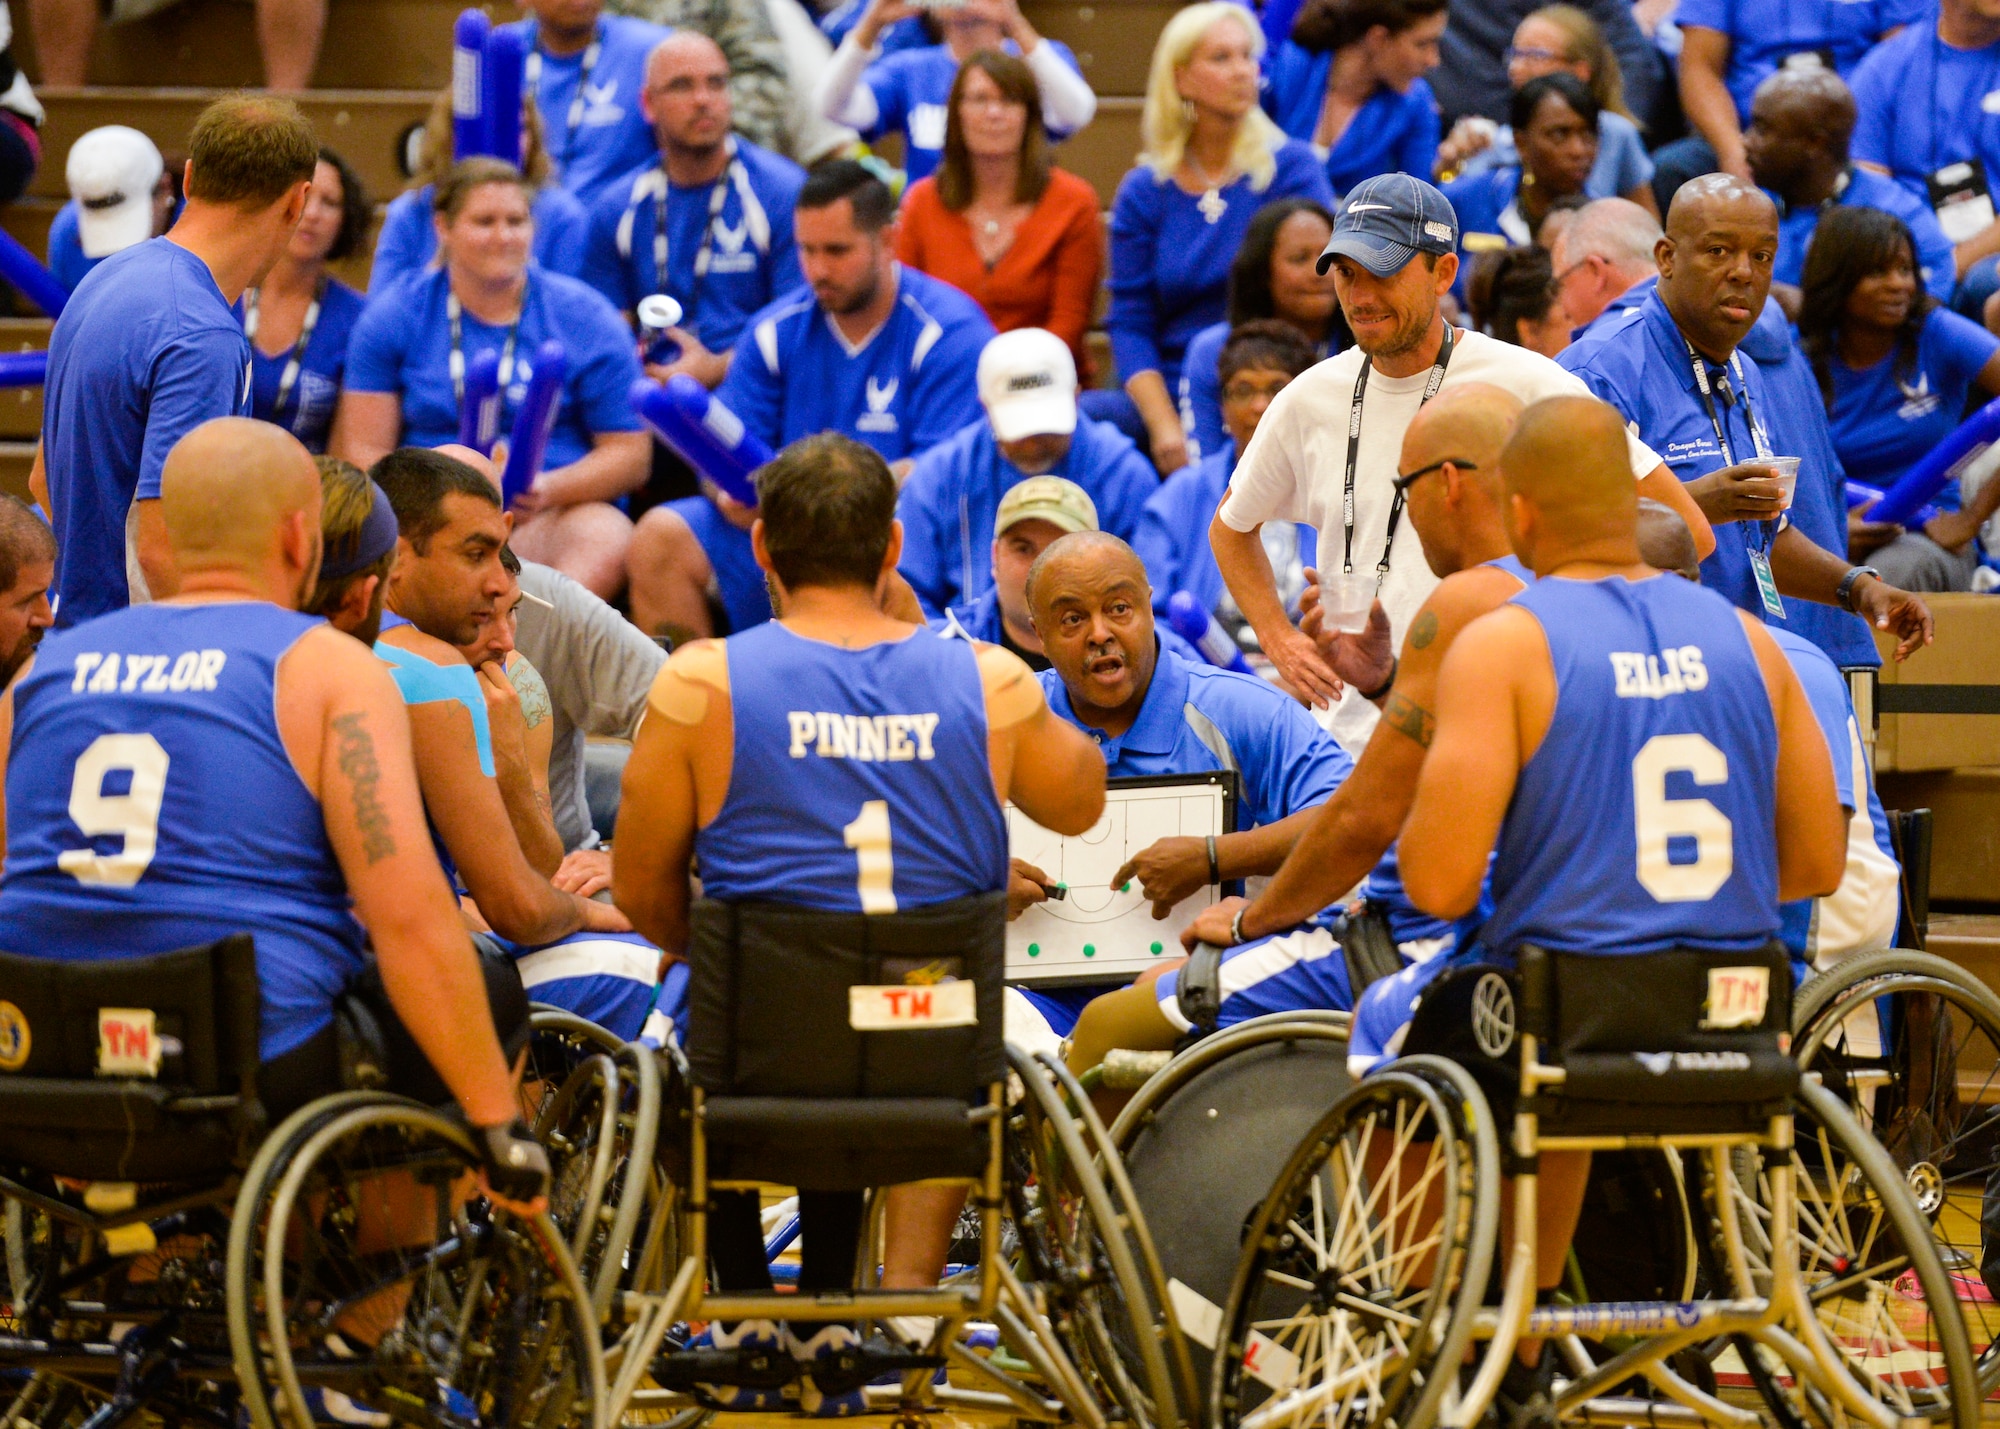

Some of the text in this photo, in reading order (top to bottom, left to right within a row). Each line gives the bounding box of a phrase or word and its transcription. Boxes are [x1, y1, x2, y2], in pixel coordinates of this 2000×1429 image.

[72, 649, 227, 693] TAYLOR
[1609, 644, 1708, 699] ELLIS
[788, 711, 940, 762] PINNEY
[57, 733, 170, 887] 9
[1633, 734, 1733, 903] 6
[843, 800, 898, 914] 1
[882, 989, 933, 1019] TM
[1718, 976, 1761, 1013] TM
[103, 1020, 149, 1060] TM
